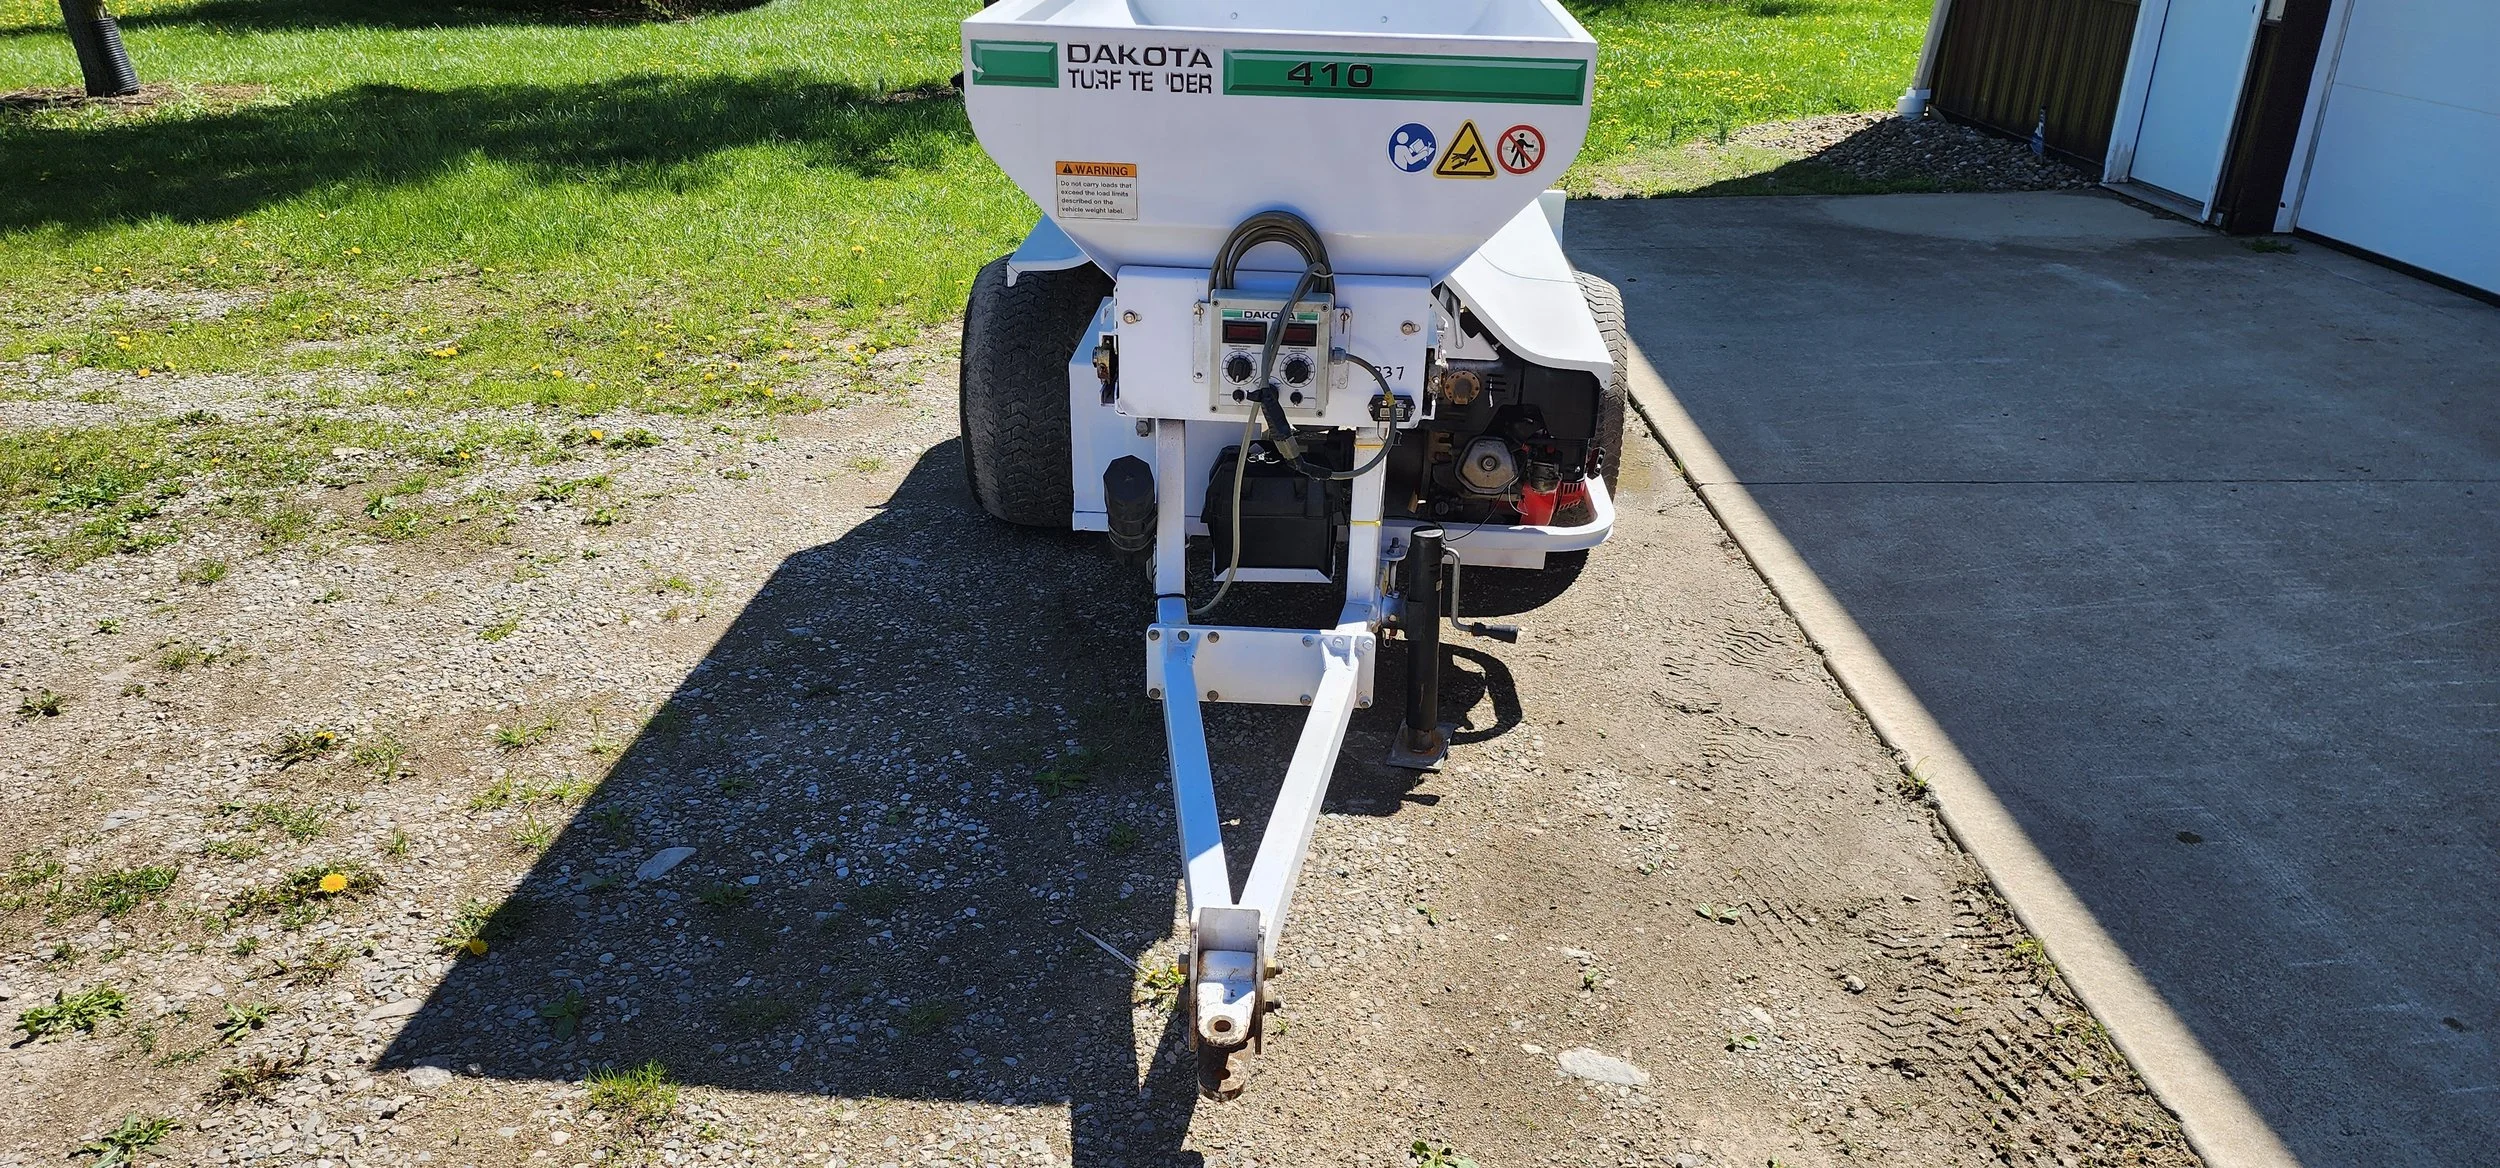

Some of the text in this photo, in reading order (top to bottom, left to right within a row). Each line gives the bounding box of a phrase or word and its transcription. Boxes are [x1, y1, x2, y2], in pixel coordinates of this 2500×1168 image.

[1067, 43, 1213, 68] DAKOTA
[1068, 68, 1212, 94] TURF TEDER
[1287, 62, 1373, 88] 410
[1075, 165, 1128, 175] WARNING
[1244, 311, 1296, 320] DAKOA
